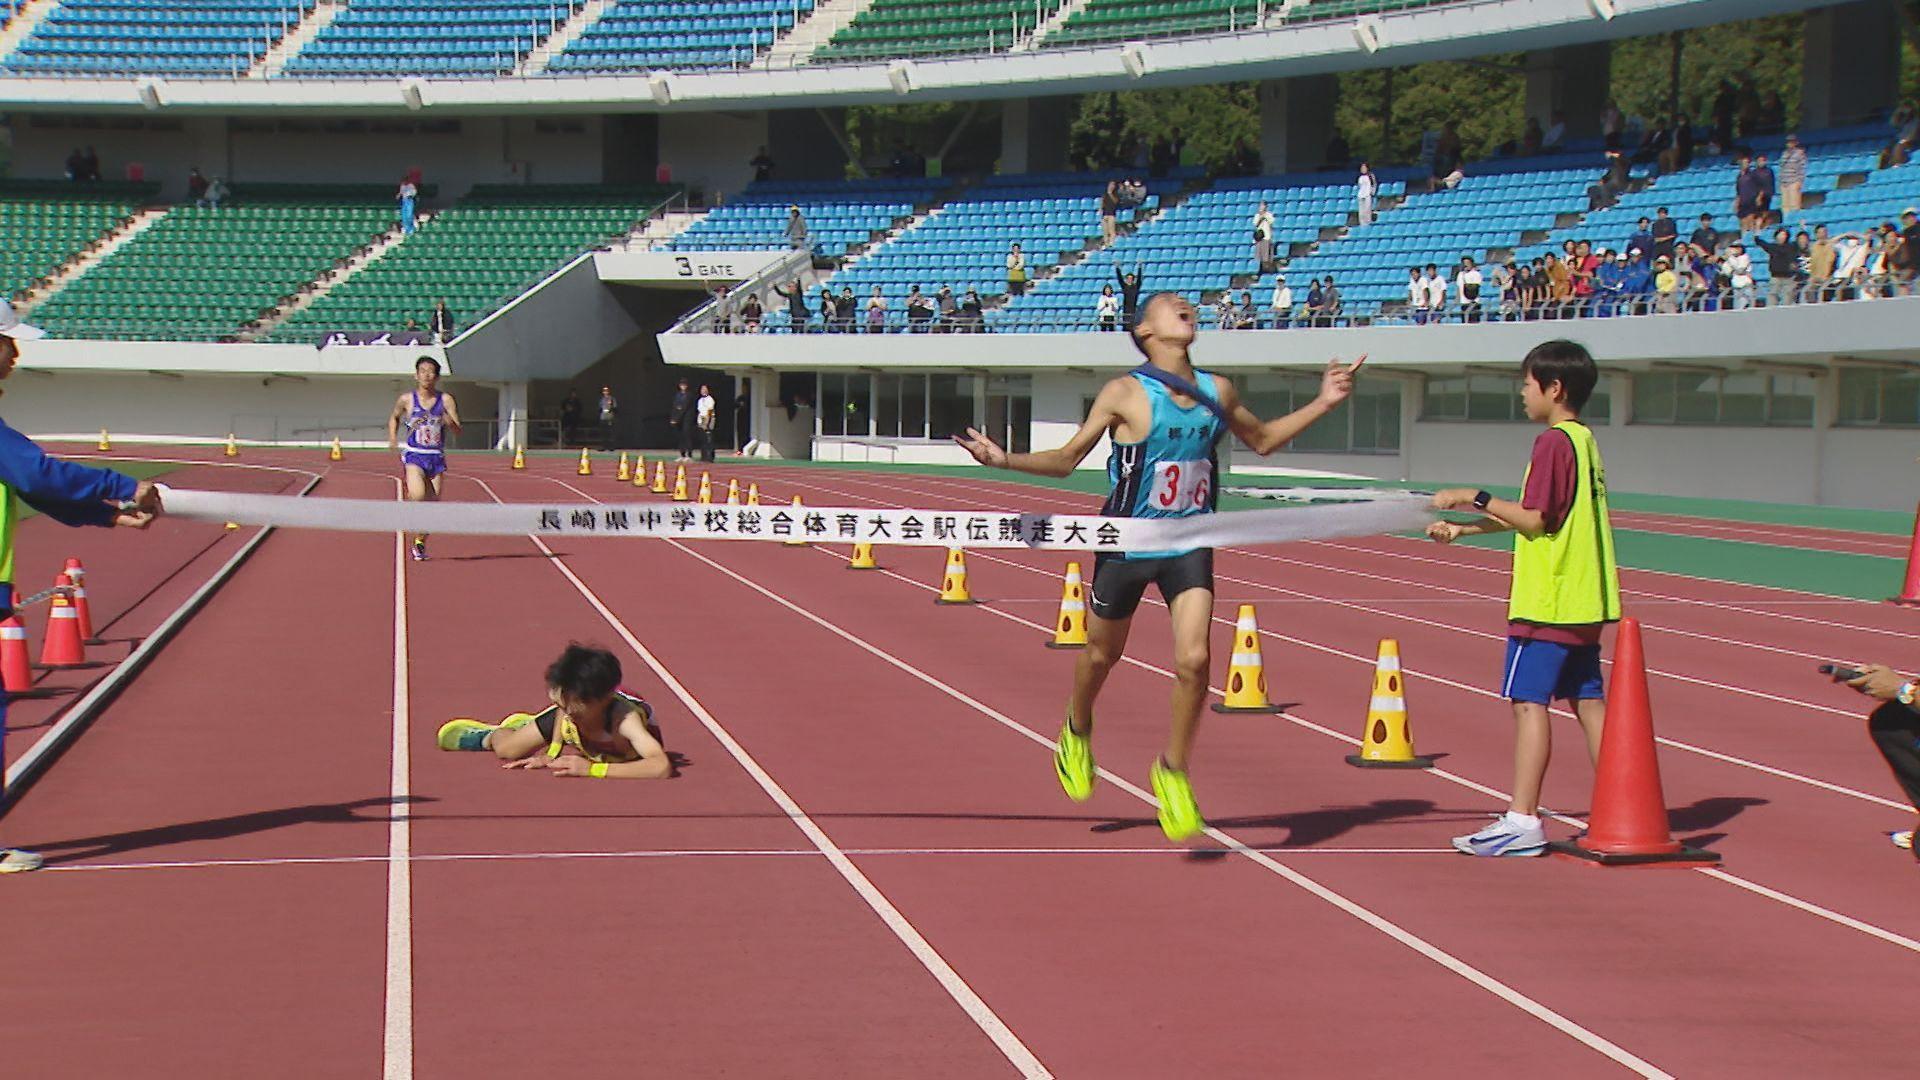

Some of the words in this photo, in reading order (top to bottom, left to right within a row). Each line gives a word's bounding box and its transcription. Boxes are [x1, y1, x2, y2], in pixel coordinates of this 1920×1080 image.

[675, 256, 693, 276] 3
[698, 264, 735, 276] GATE
[538, 508, 1121, 546] 長崎県中学校総合体育大会駅伝競走大会
